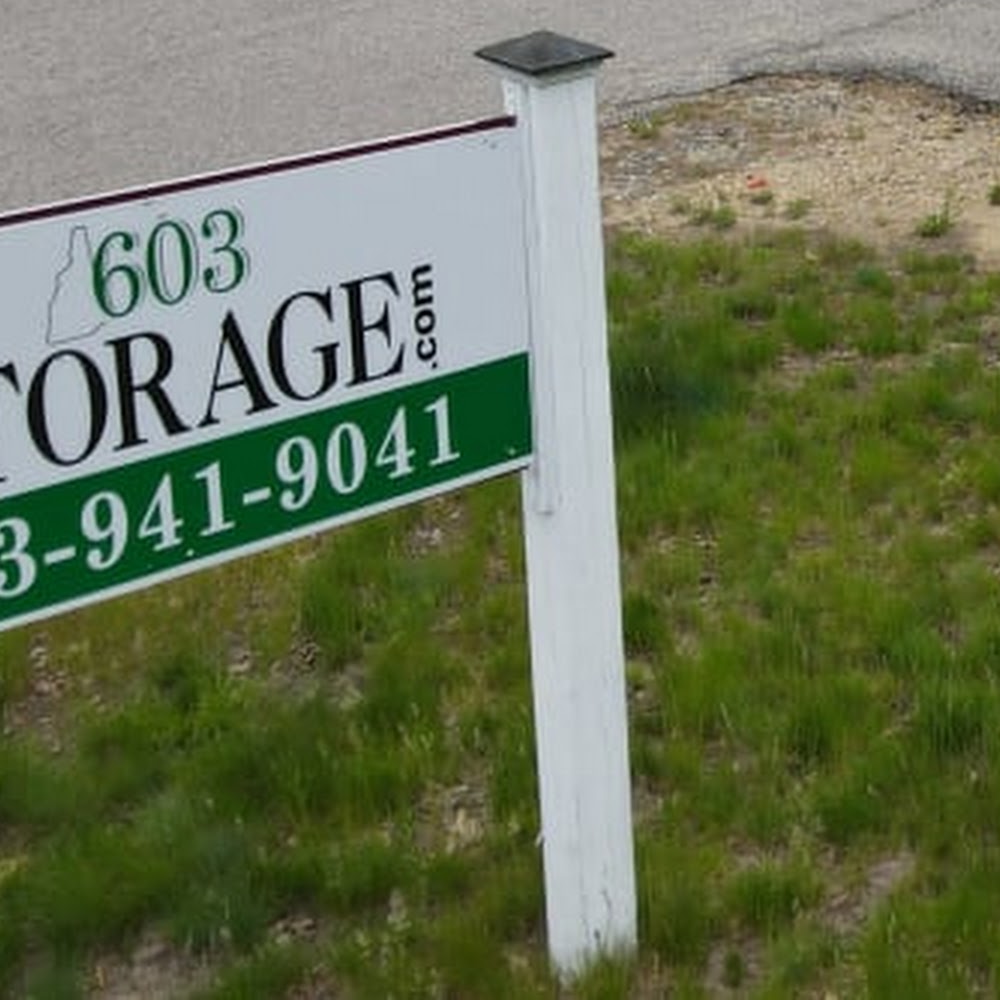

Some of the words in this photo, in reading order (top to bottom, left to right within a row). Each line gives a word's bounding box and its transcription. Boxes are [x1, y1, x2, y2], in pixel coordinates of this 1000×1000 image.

[92, 209, 247, 318] 603
[410, 263, 438, 370] .com
[0, 271, 405, 483] ORAGE
